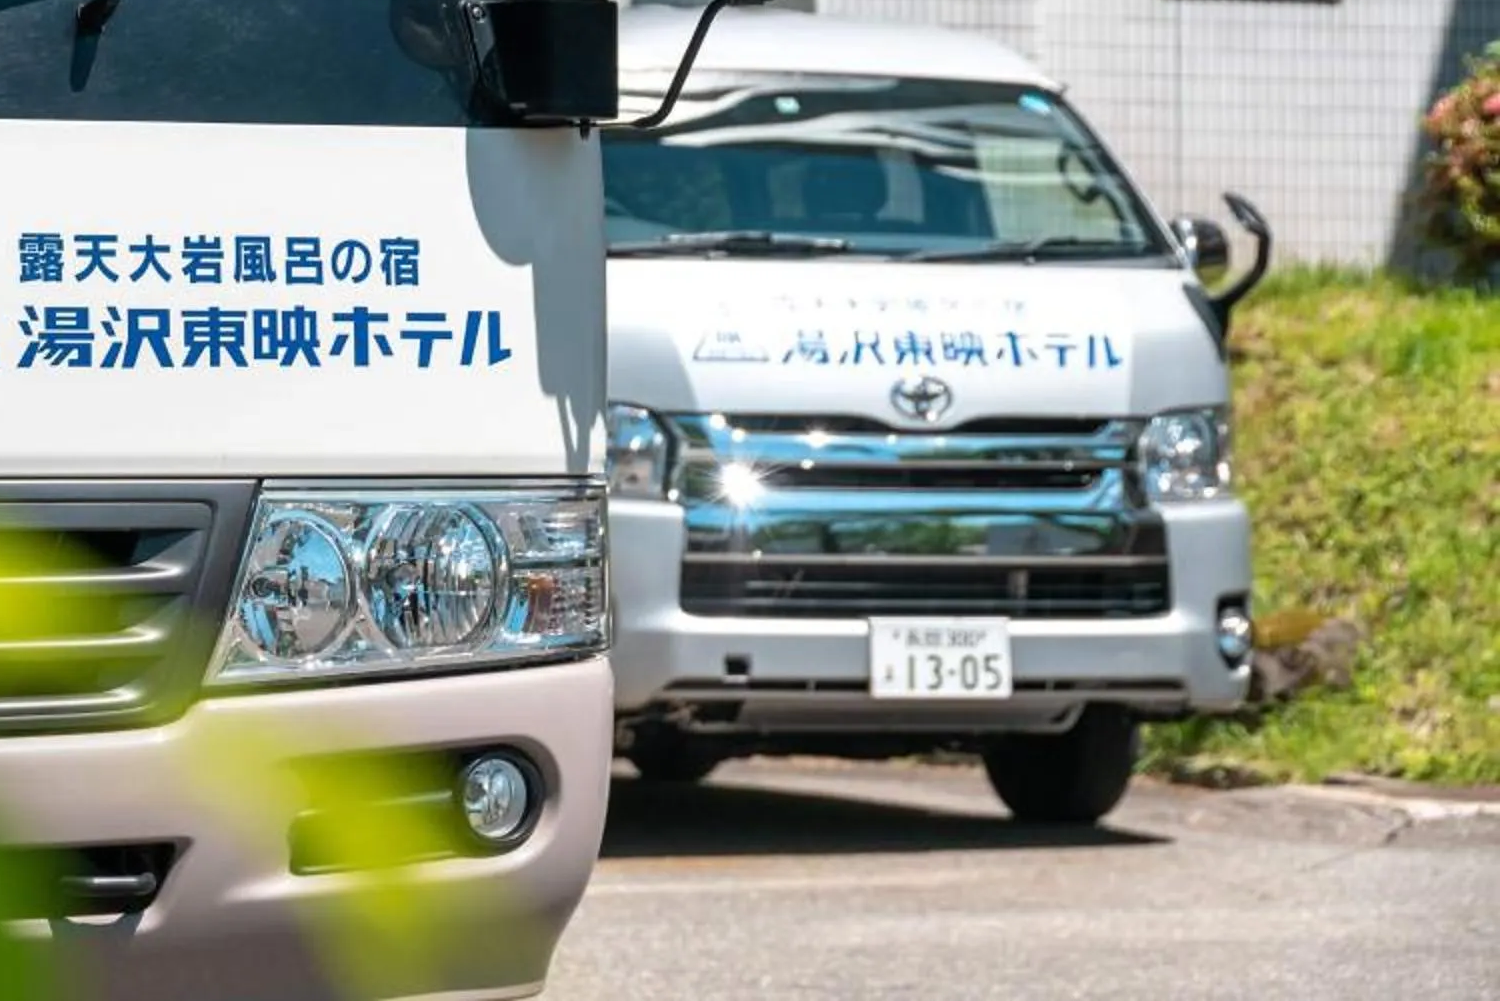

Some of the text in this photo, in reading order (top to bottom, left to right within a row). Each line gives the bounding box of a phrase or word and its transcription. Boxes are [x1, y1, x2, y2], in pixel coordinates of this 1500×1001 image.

[18, 232, 421, 287] 露天大岩風呂の宿
[16, 303, 512, 369] 湯沢東映ホテル
